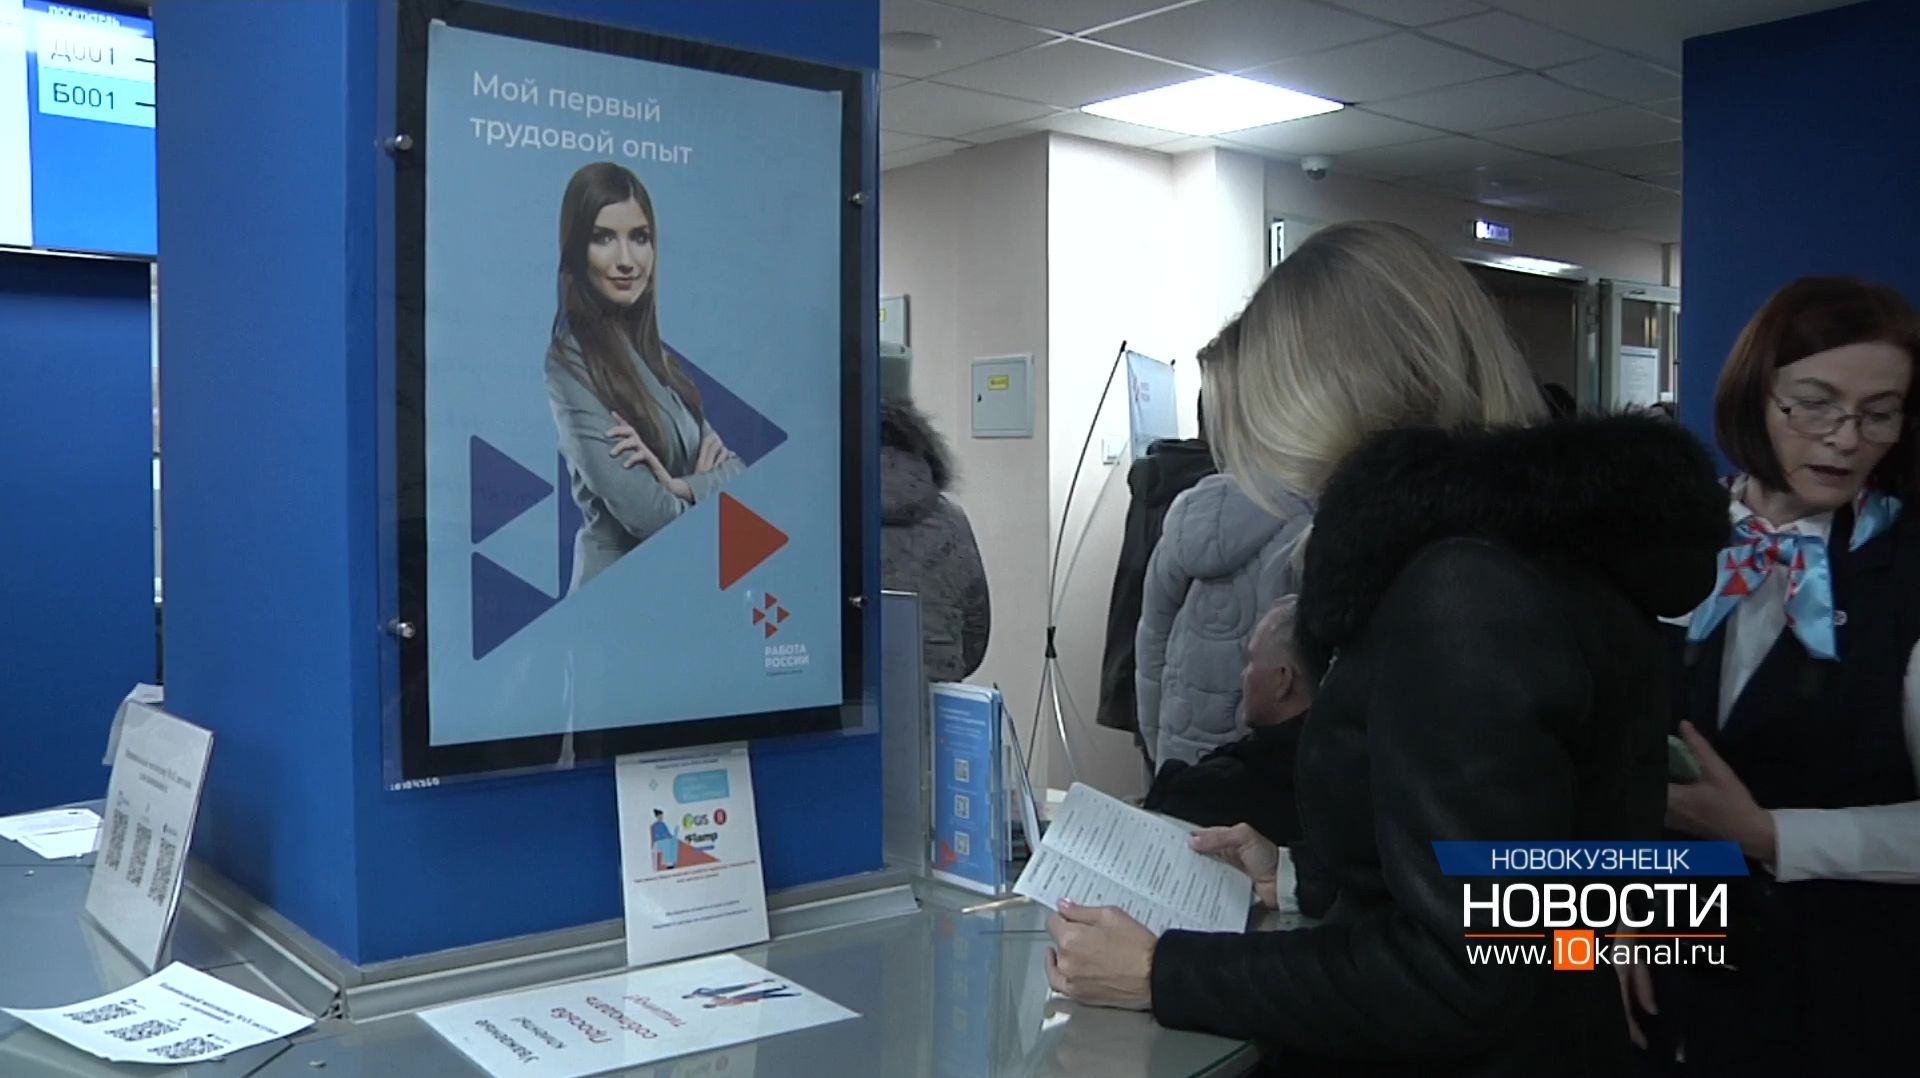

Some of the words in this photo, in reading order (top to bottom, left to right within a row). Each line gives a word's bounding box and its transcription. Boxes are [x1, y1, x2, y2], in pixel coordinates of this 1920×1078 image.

[51, 37, 117, 66] Д001
[53, 82, 116, 110] Б001
[473, 71, 538, 105] Мой
[549, 87, 661, 122] первый
[470, 117, 614, 155] трудовой
[622, 138, 693, 164] опыт
[765, 643, 806, 656] РАБОТА
[765, 655, 809, 668] РОССИИ
[550, 1006, 612, 1043] Просьба
[586, 996, 658, 1039] соблюдать
[475, 1019, 539, 1064] Уважаемые
